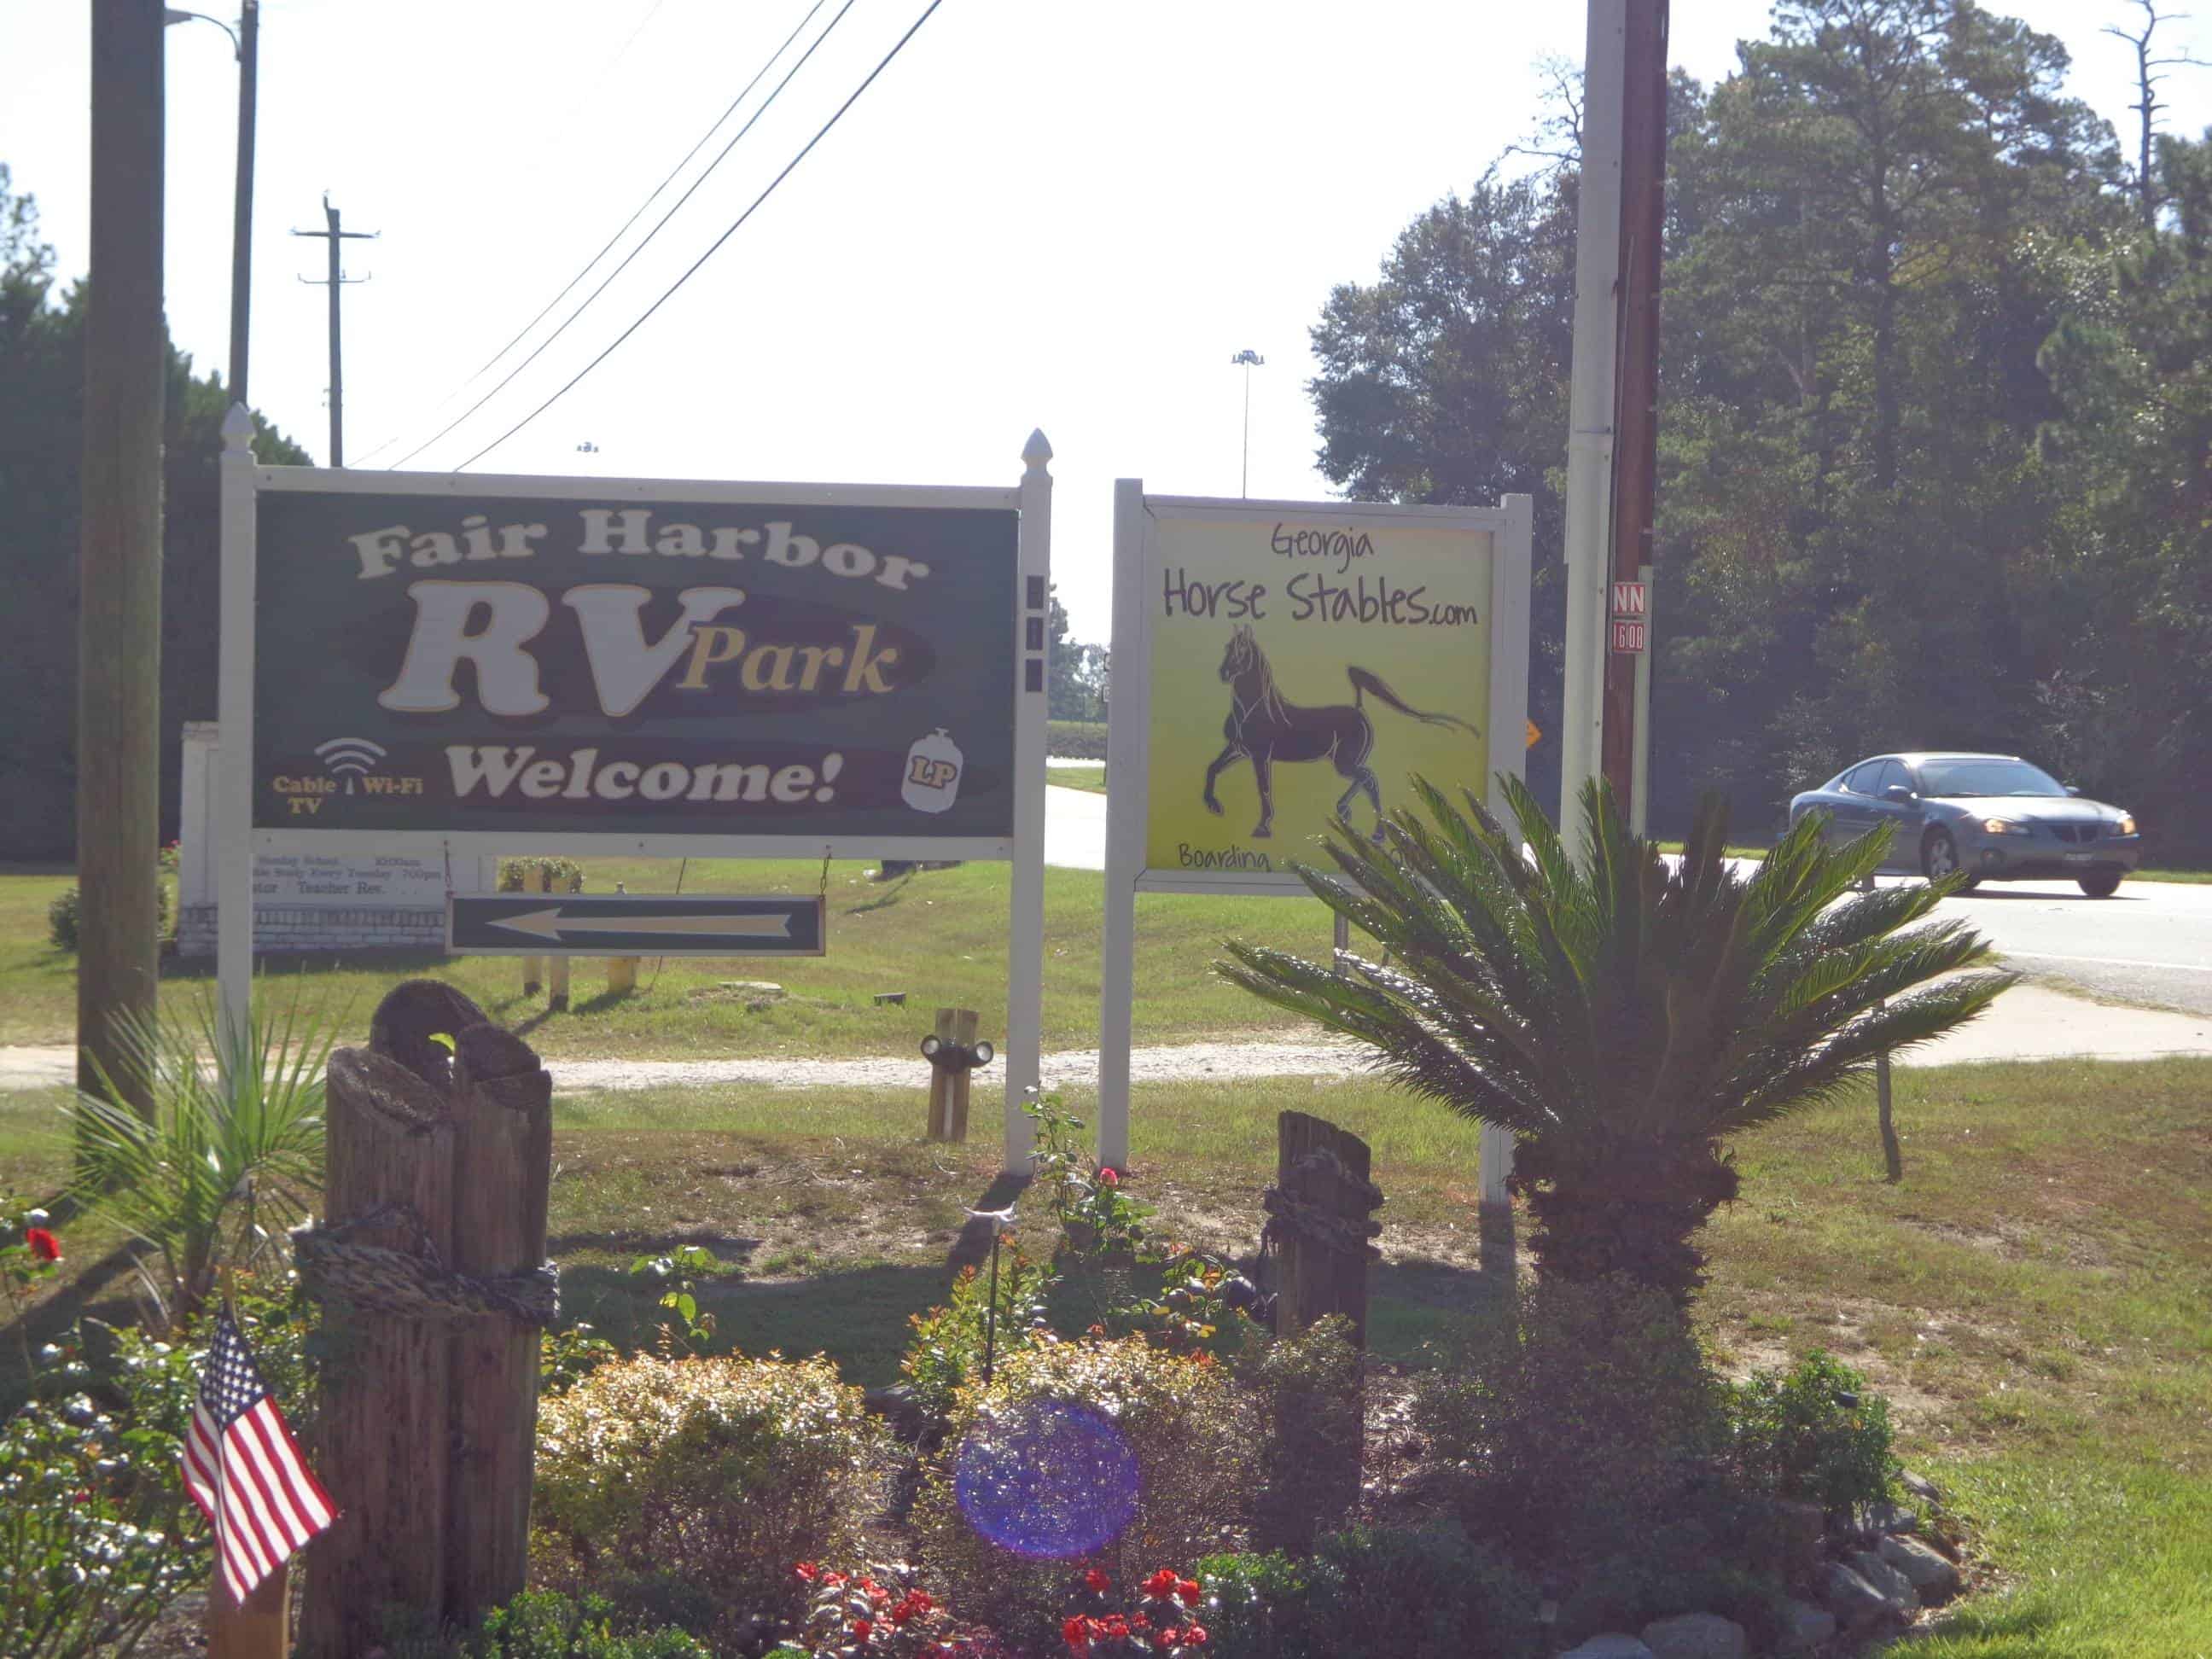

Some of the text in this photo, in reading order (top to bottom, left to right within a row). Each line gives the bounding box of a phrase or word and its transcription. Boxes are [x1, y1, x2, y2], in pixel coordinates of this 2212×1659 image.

[349, 509, 931, 591] Fair Harbor
[1271, 523, 1373, 573] Georgia
[1164, 568, 1478, 626] Horse Stables.com
[1614, 586, 1644, 612] NN
[378, 579, 898, 718] RV Park
[272, 775, 424, 795] Cable Wi-Fi
[445, 745, 844, 802] Welcome!
[909, 757, 957, 789] LP
[287, 797, 323, 814] TV
